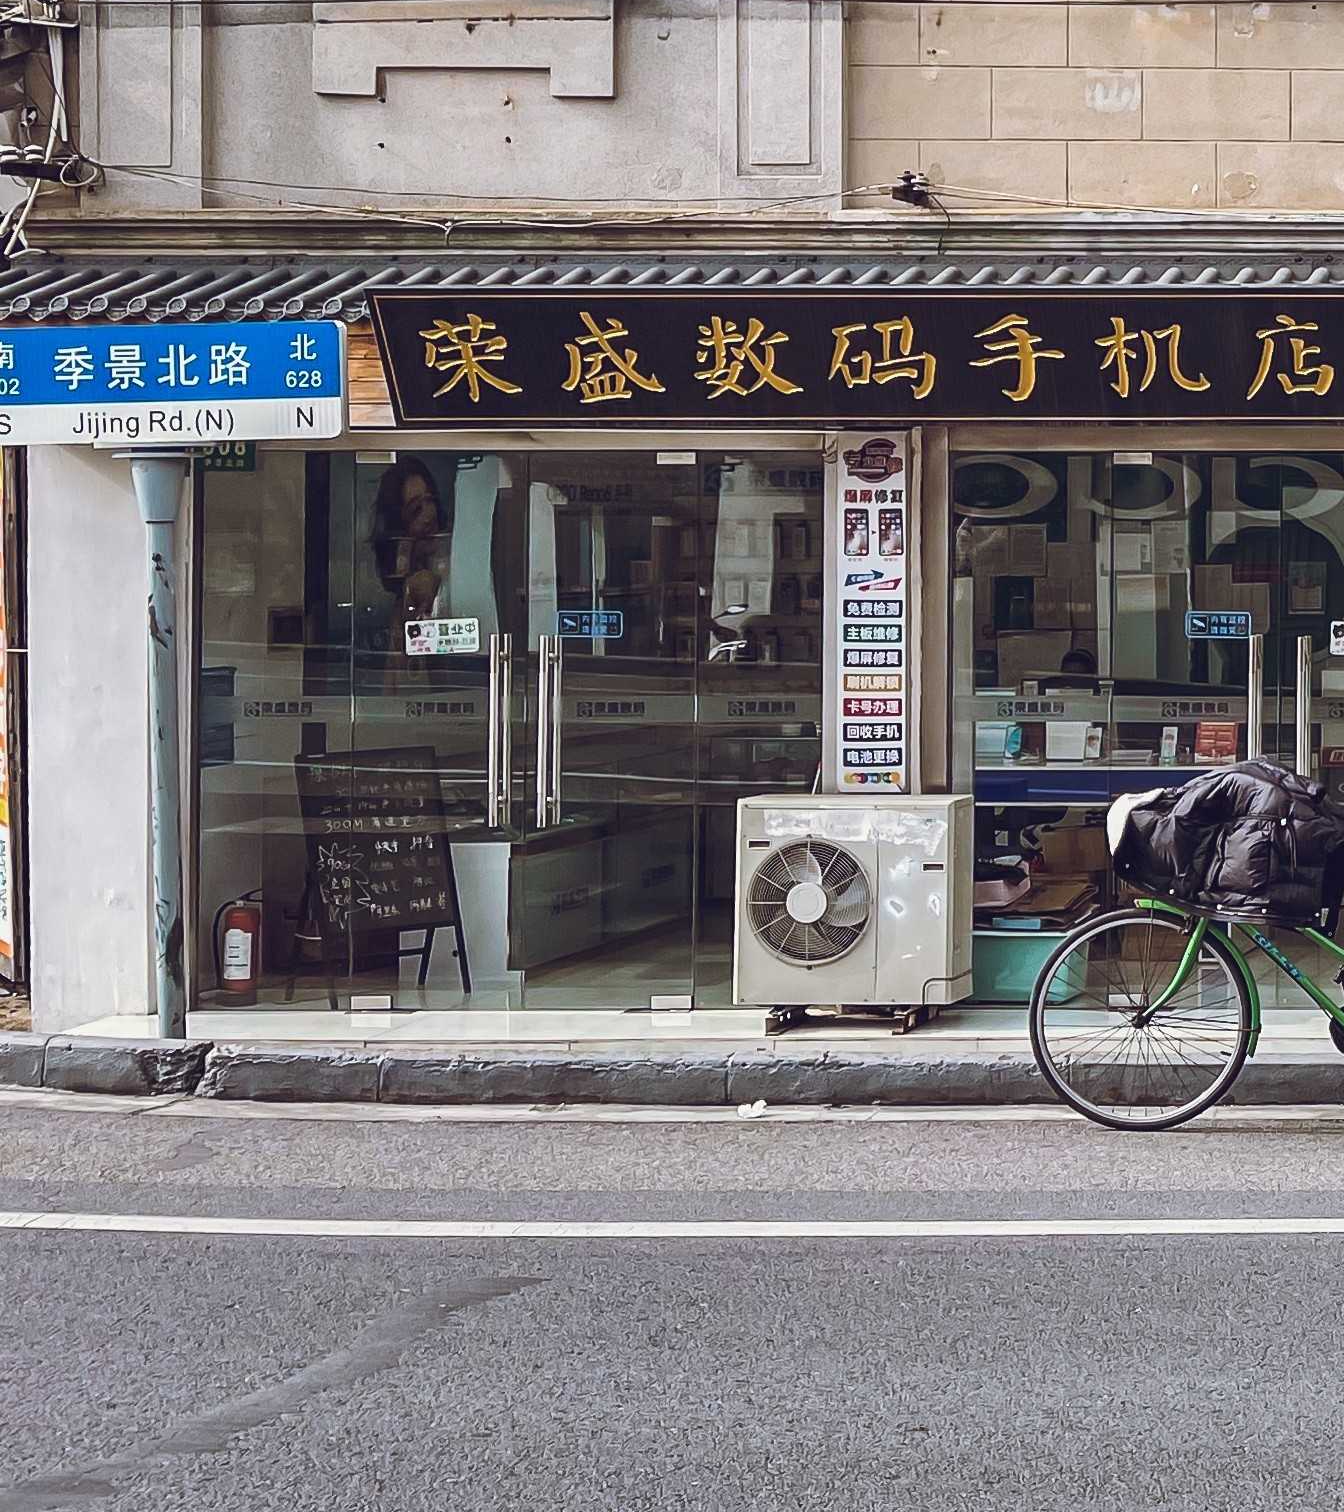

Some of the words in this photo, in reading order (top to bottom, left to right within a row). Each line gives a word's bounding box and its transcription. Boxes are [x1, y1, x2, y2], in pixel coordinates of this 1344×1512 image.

[53, 343, 251, 391] 季景北路
[289, 333, 318, 361] 北
[418, 312, 1336, 404] 荣盛数码手机店
[285, 370, 322, 389] 628
[73, 411, 140, 438] Jijing
[148, 408, 235, 437] Rd.(N)
[296, 406, 314, 428] N
[847, 725, 900, 740] 回收手机
[847, 750, 900, 765] 电池更换
